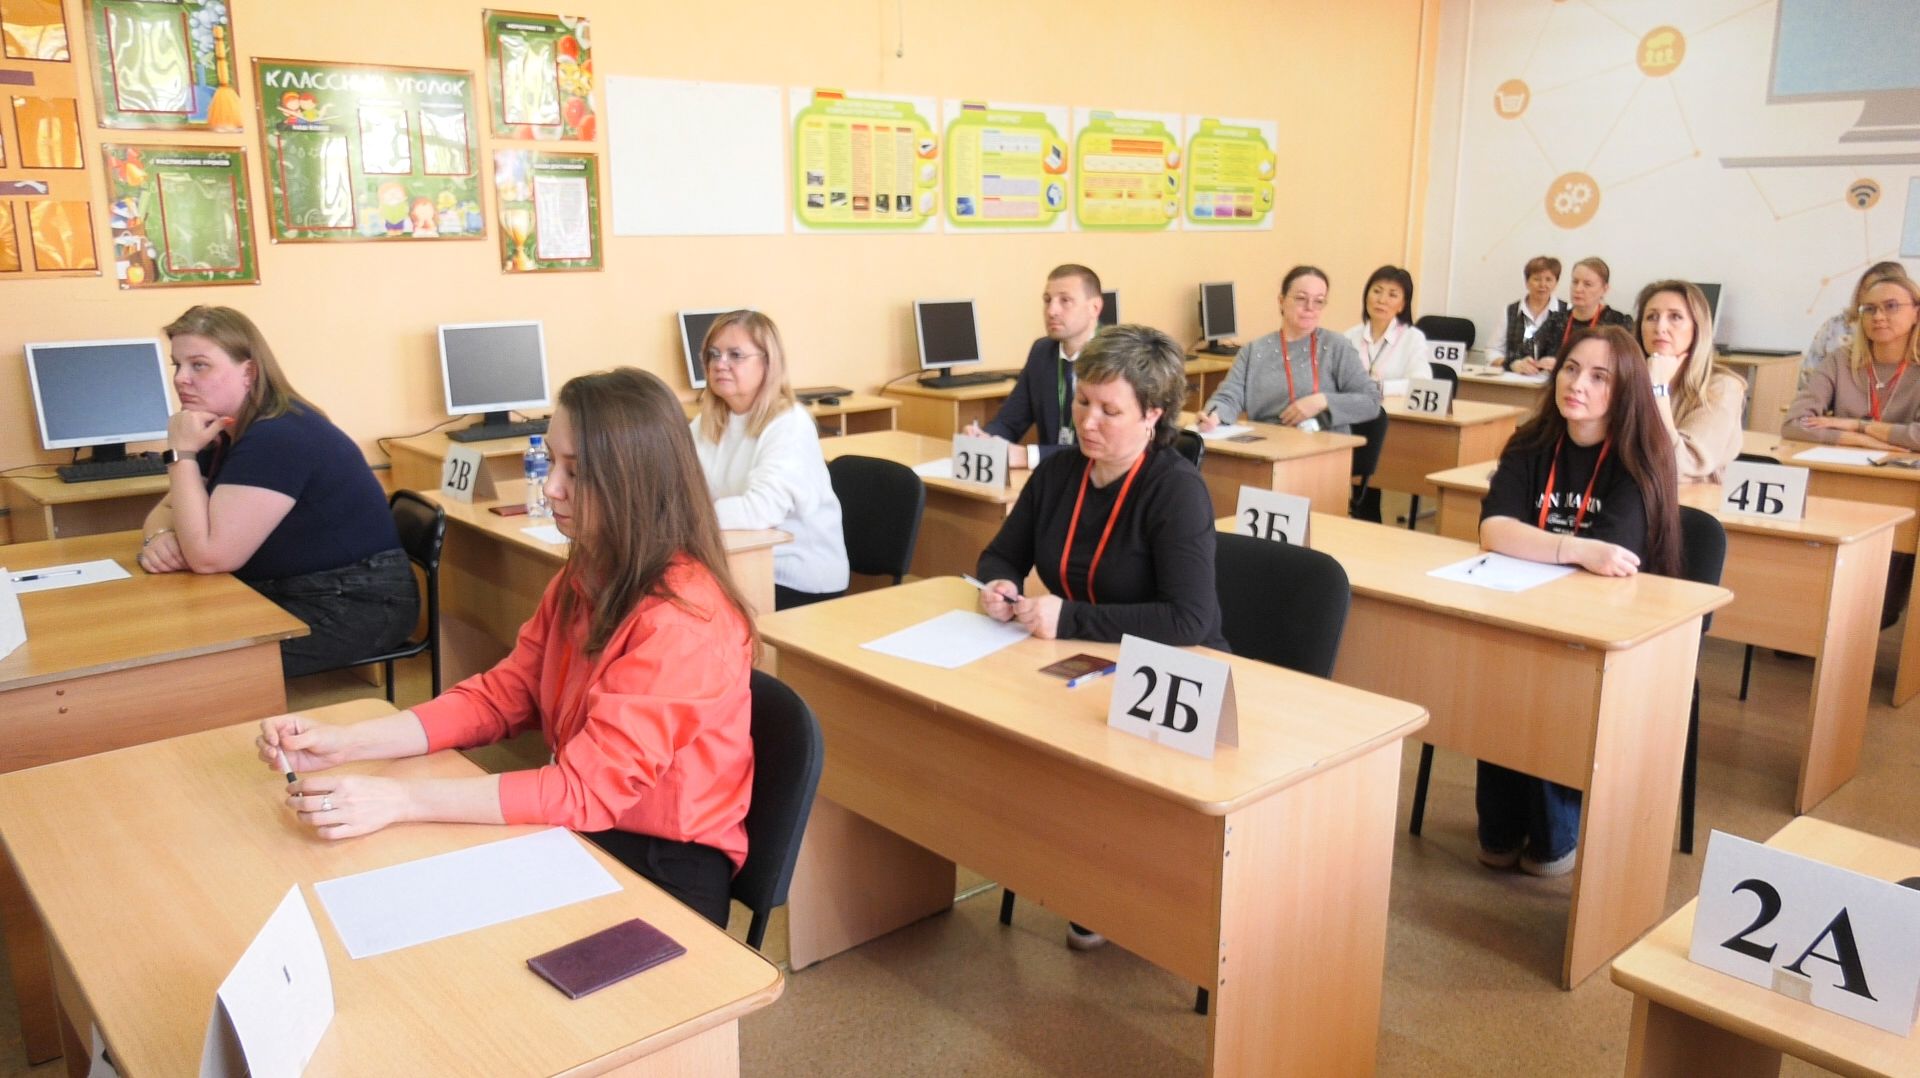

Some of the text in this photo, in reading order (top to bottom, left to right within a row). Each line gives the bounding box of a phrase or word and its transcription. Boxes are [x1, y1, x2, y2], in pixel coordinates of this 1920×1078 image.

[395, 79, 466, 97] УГОЛОК
[1434, 346, 1459, 360] 6В
[1407, 389, 1439, 412] 5В
[447, 458, 471, 490] 2В
[956, 451, 993, 483] 3В
[1728, 479, 1785, 515] 4Б
[1243, 508, 1290, 544] 3Б
[1126, 665, 1203, 733] 2Б
[1720, 879, 1878, 1002] 2А
